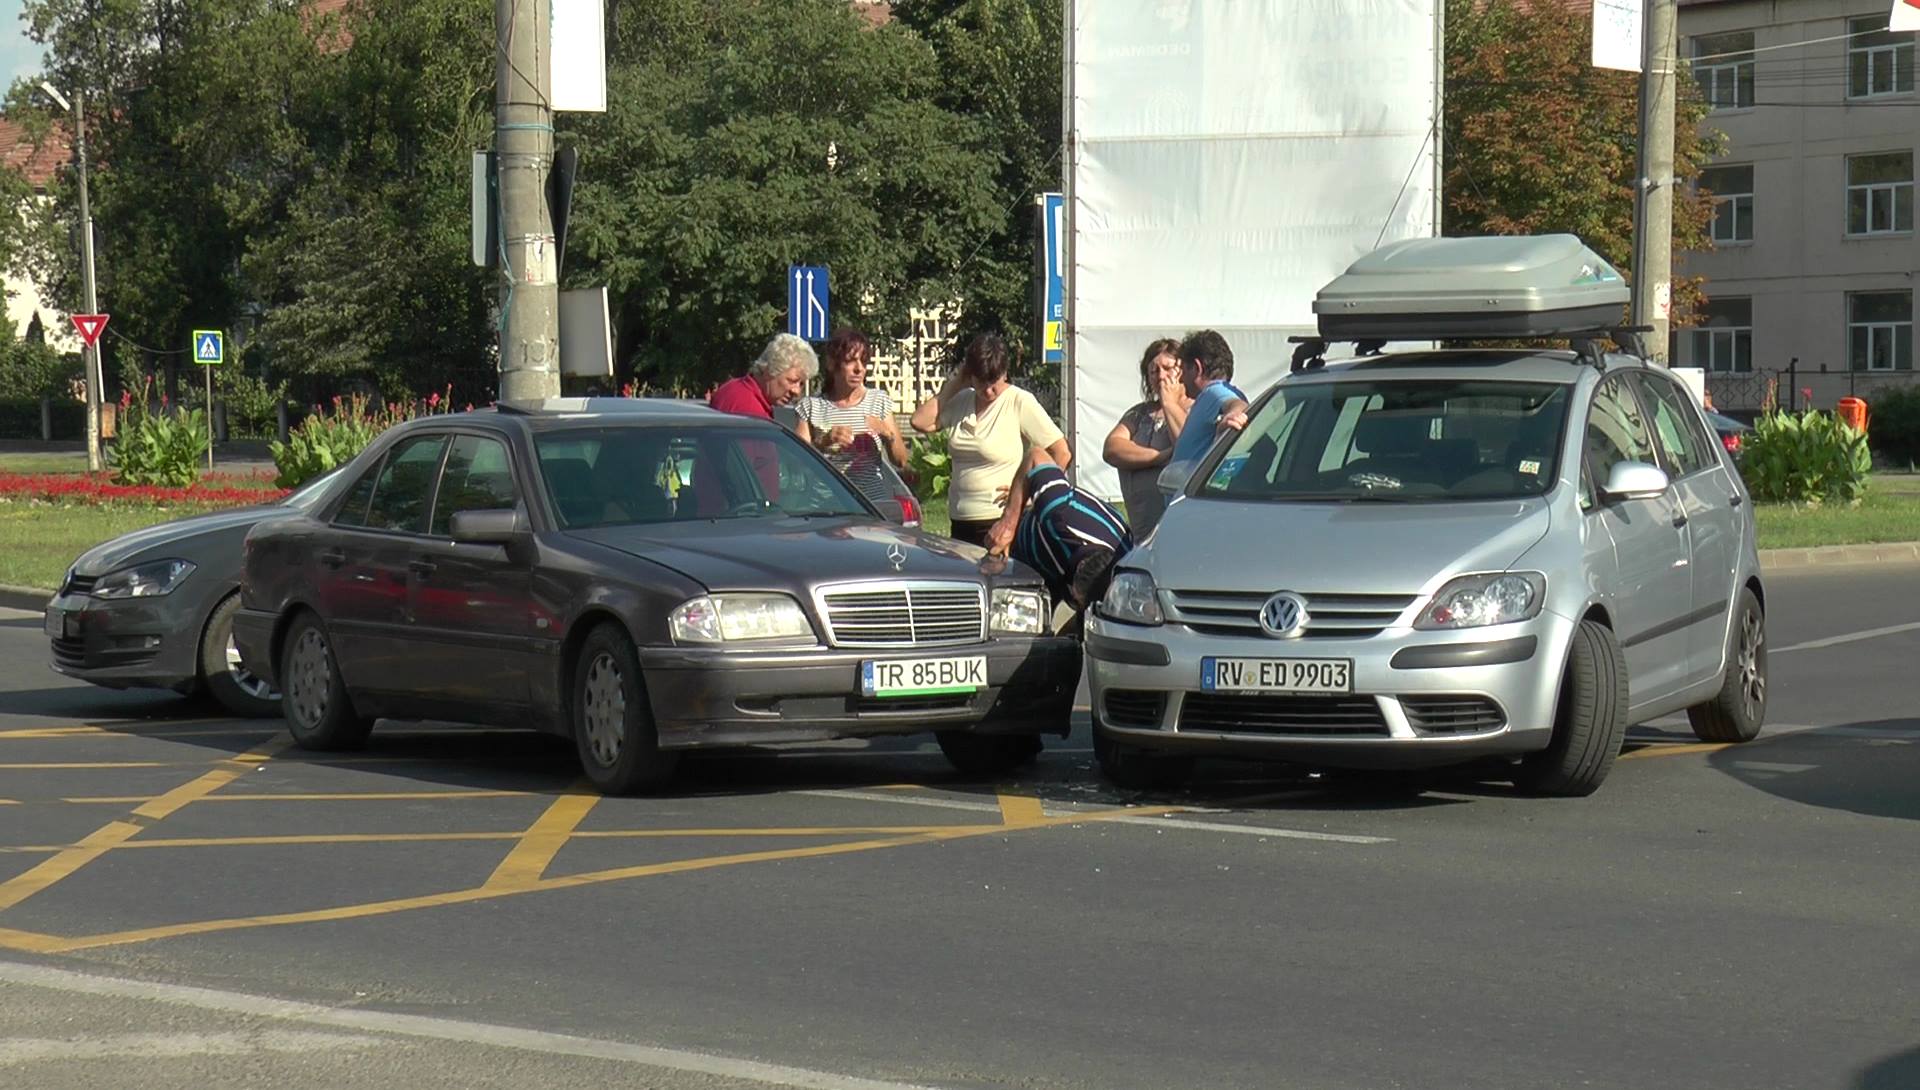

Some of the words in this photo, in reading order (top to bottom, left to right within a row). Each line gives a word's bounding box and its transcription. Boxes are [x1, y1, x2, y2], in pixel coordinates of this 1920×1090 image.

[876, 664, 903, 687] TR
[912, 663, 936, 685] 85
[940, 660, 982, 684] BUK
[1217, 662, 1243, 686] RV
[1260, 663, 1287, 687] ED
[1294, 664, 1346, 687] 9903
